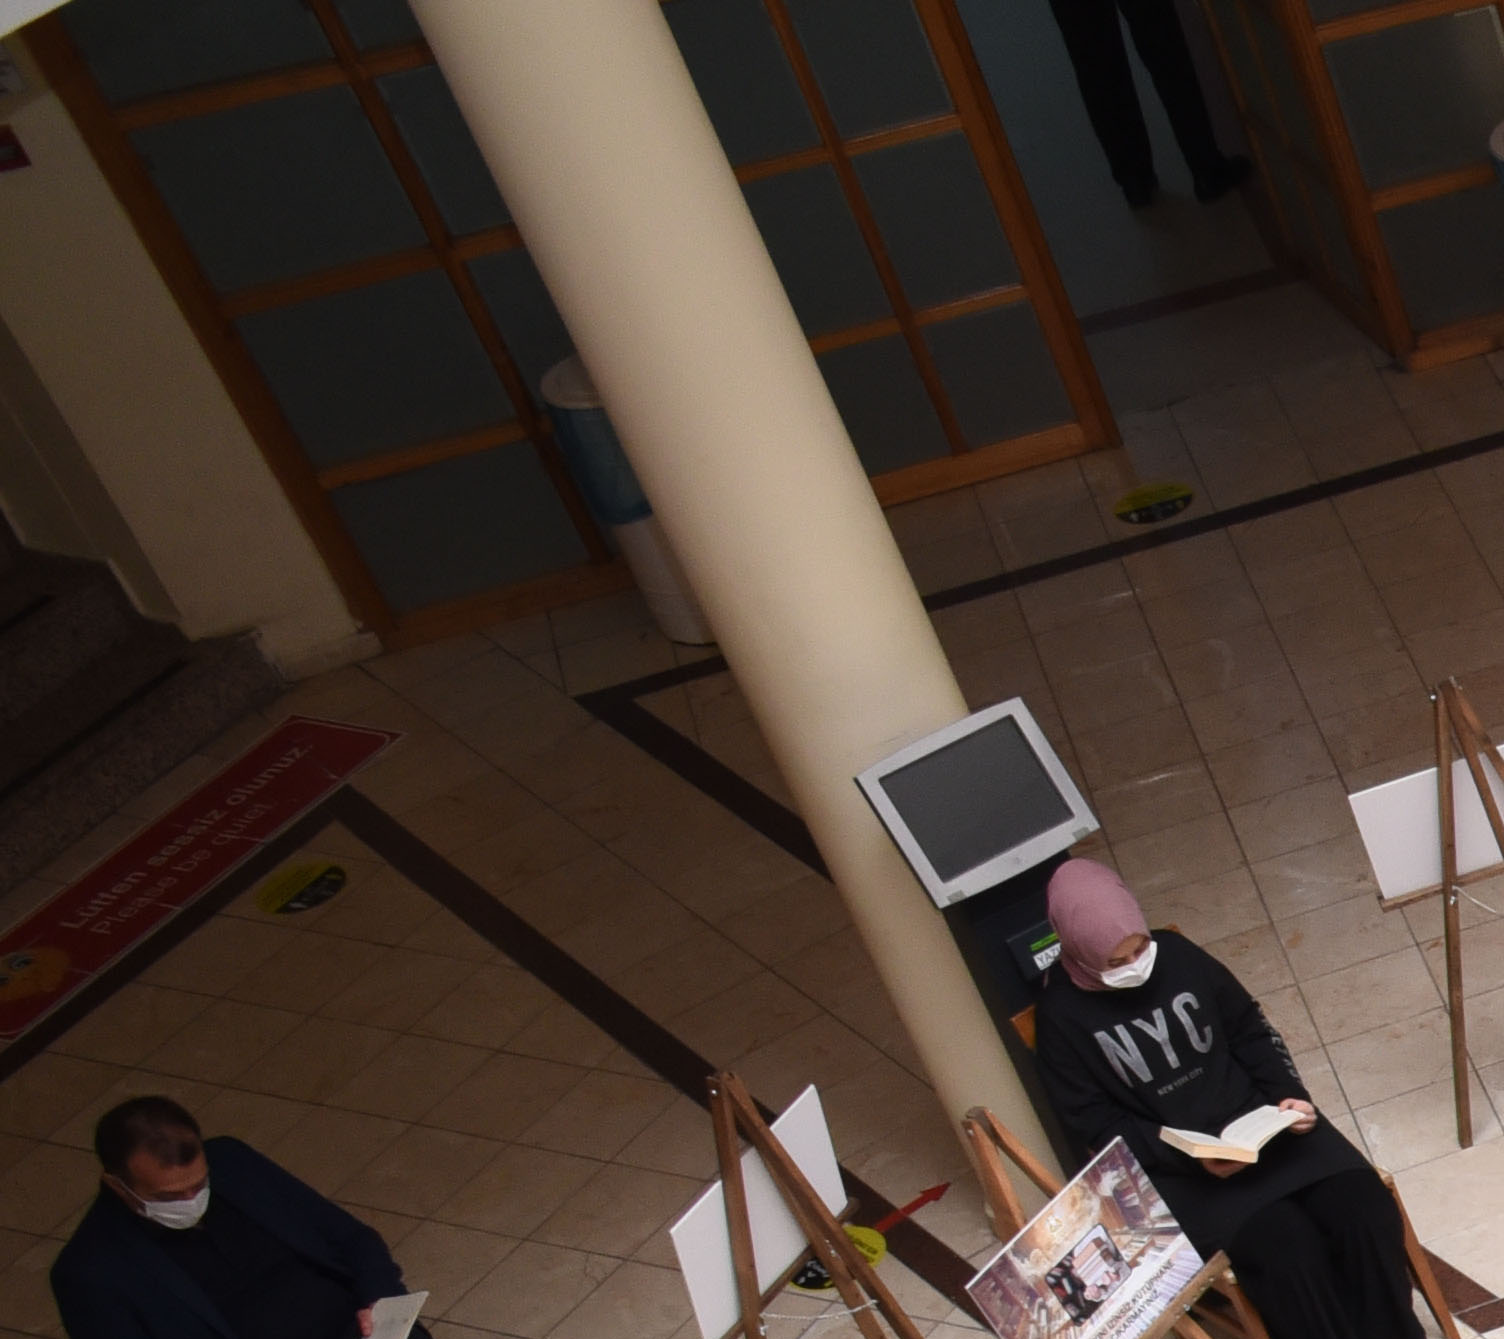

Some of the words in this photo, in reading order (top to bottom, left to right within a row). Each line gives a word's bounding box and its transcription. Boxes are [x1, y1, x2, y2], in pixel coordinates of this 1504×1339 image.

[59, 871, 148, 929] Lütfen
[147, 808, 229, 867] sessiz
[90, 876, 179, 935] Please
[172, 848, 212, 873] be
[1094, 991, 1213, 1088] NYC
[1157, 1084, 1174, 1096] NEW
